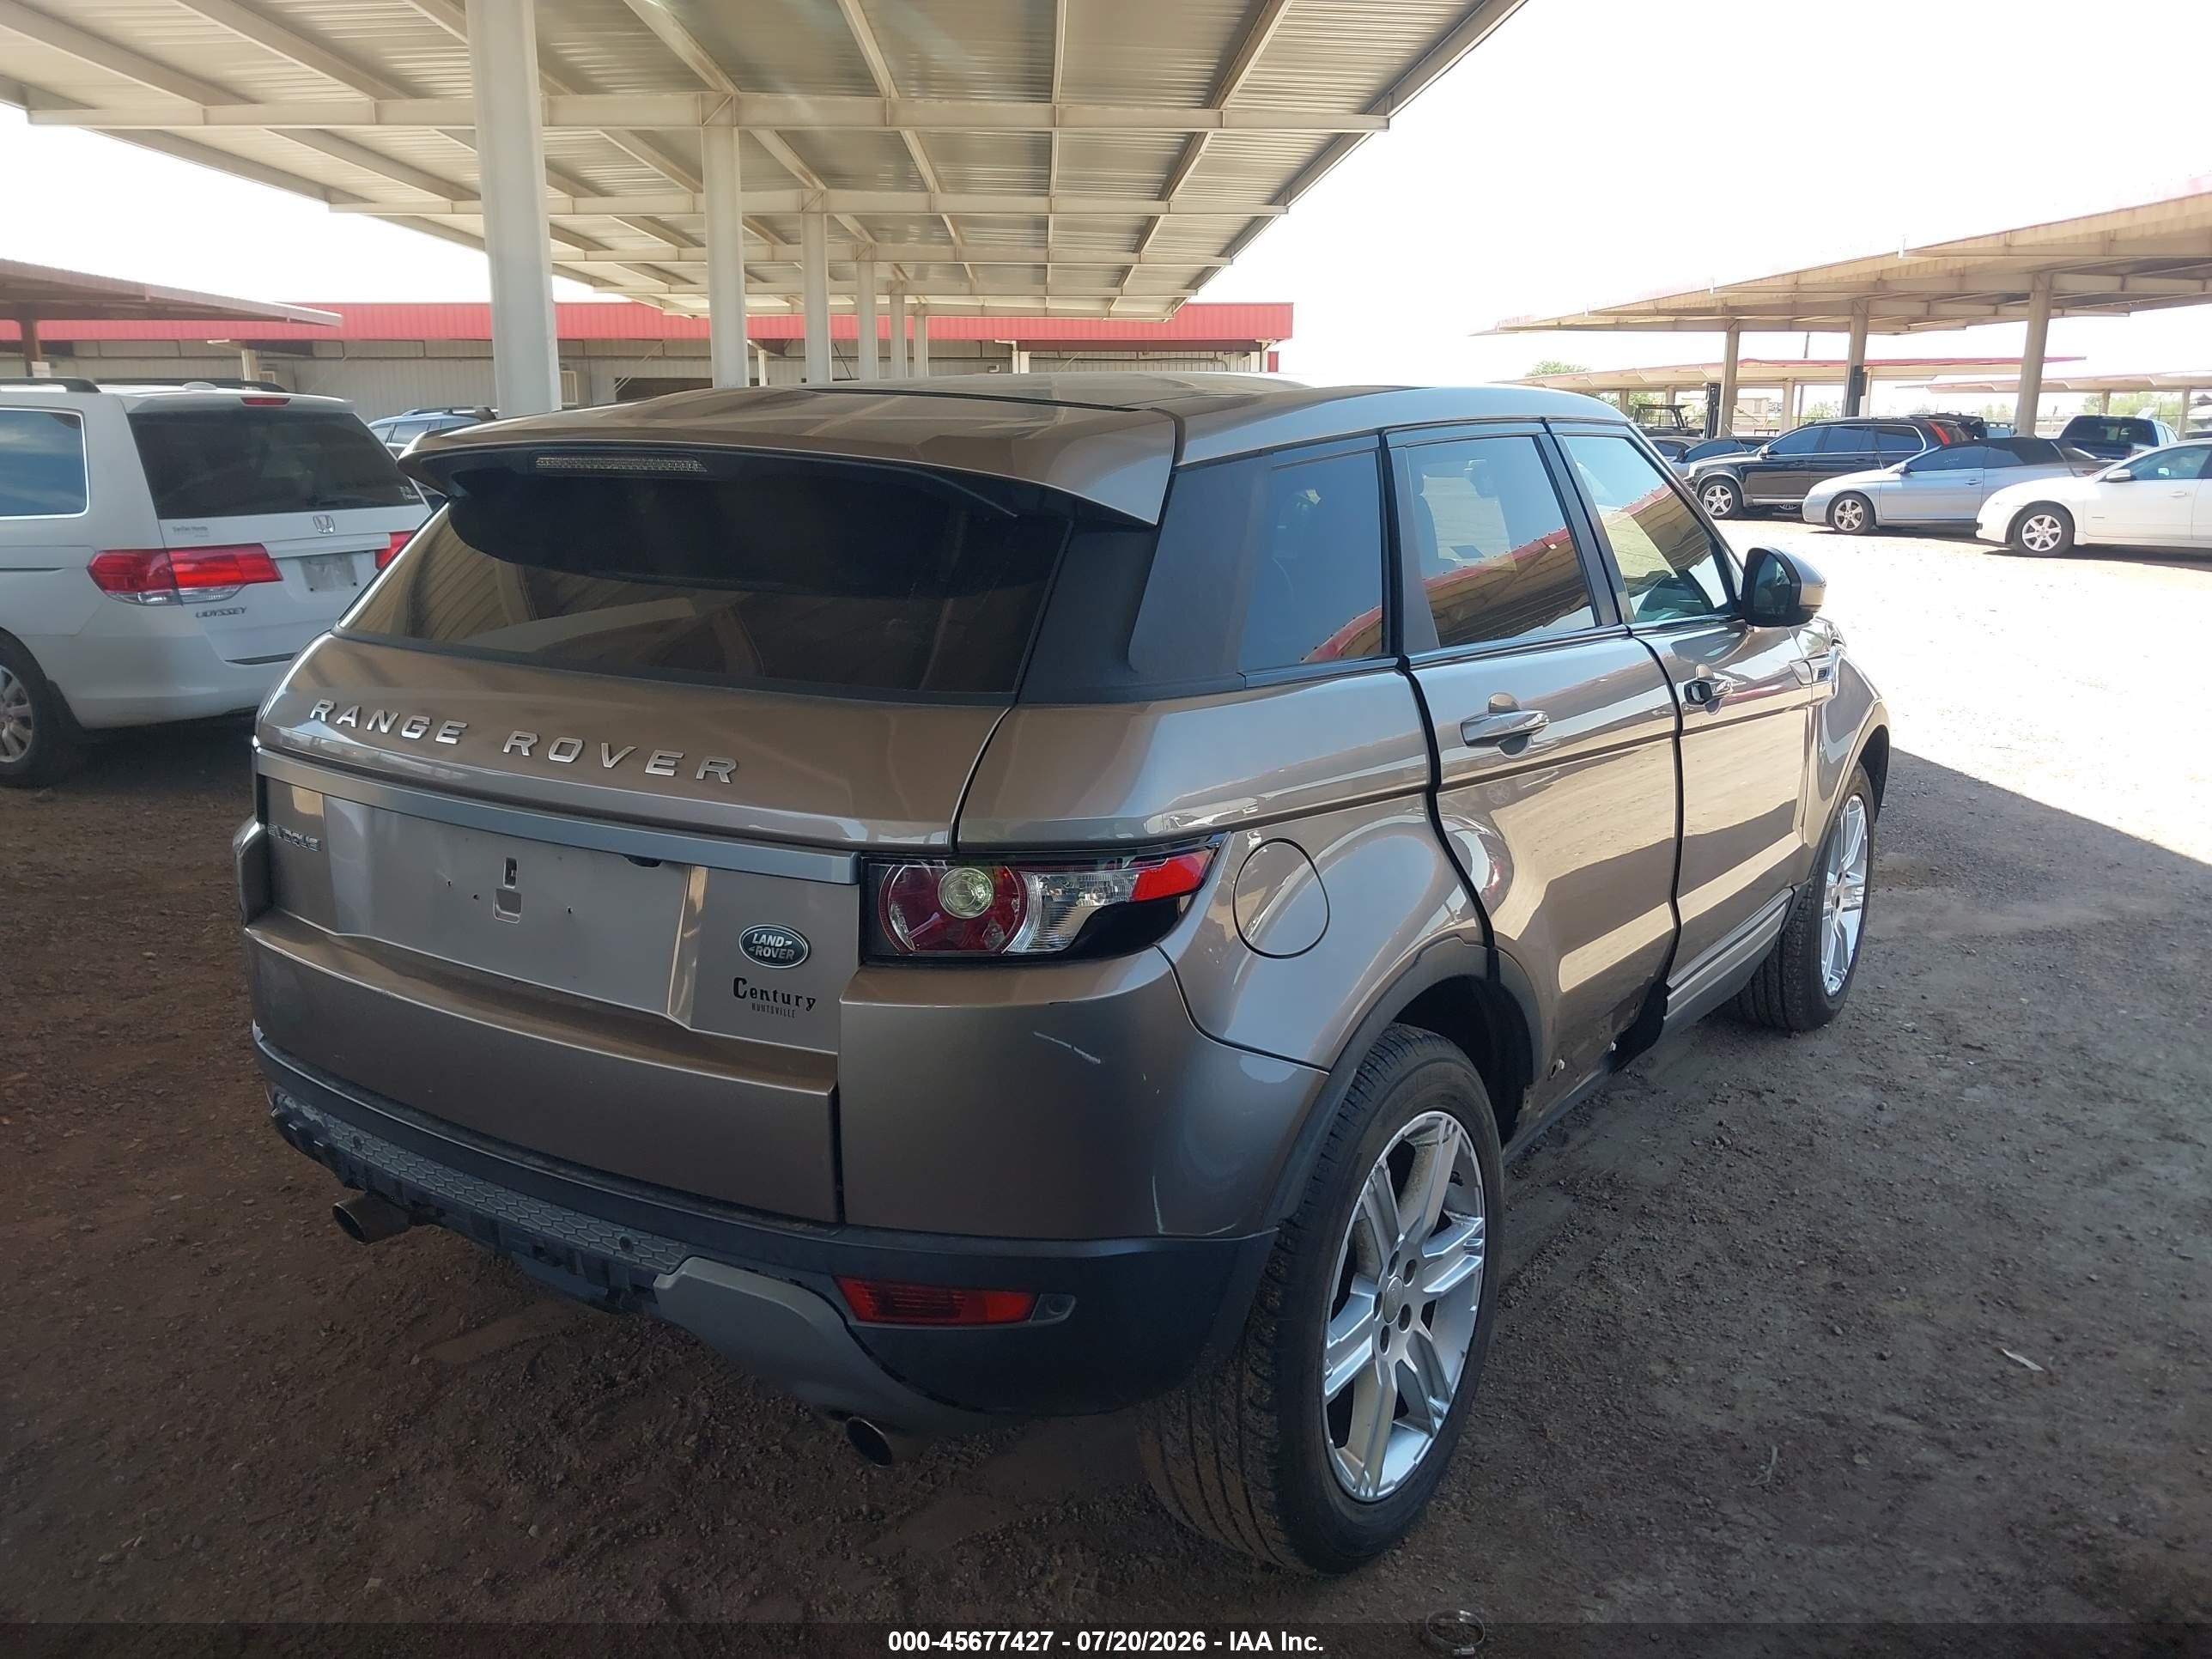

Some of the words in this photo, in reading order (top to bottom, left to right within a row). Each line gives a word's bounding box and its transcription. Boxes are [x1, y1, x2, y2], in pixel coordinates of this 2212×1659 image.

[195, 606, 247, 619] ODYSSEY
[309, 697, 469, 745] RANGE
[502, 730, 738, 784] ROVER
[752, 933, 784, 947] LAND
[755, 945, 795, 961] ROVER
[732, 976, 817, 1012] Century
[752, 1002, 795, 1018] HUNTSVILLE
